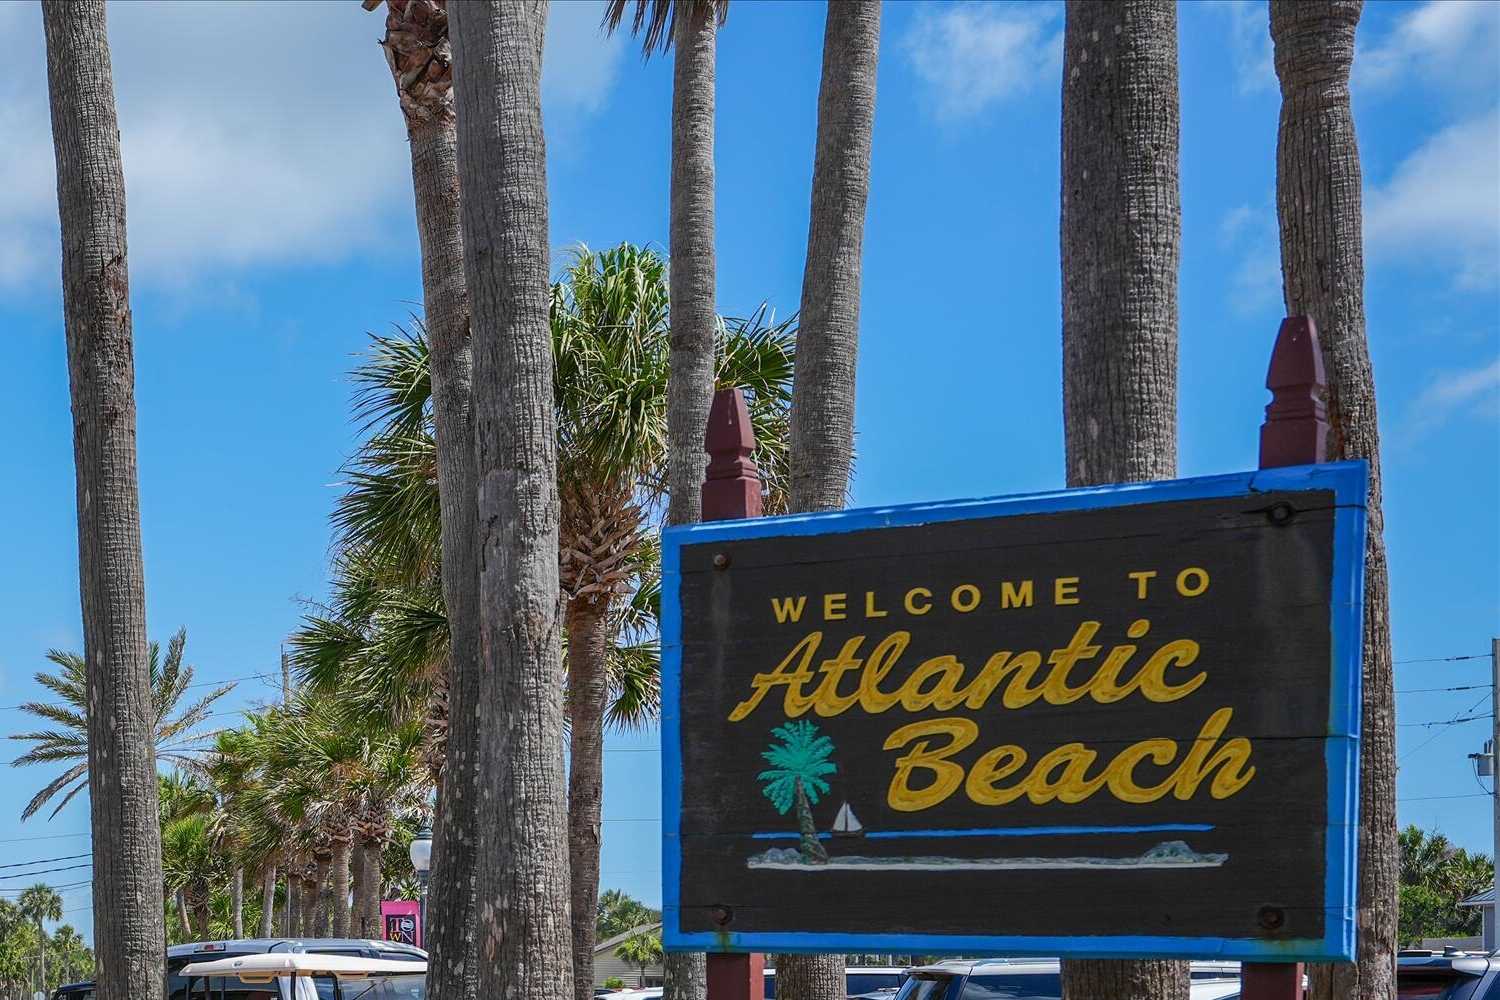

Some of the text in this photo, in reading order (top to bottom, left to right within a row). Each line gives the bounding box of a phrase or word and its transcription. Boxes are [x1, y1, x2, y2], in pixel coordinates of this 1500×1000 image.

[772, 566, 1211, 624] WELCOME TO
[727, 618, 1208, 722] Atlantic
[882, 706, 1256, 812] Beach
